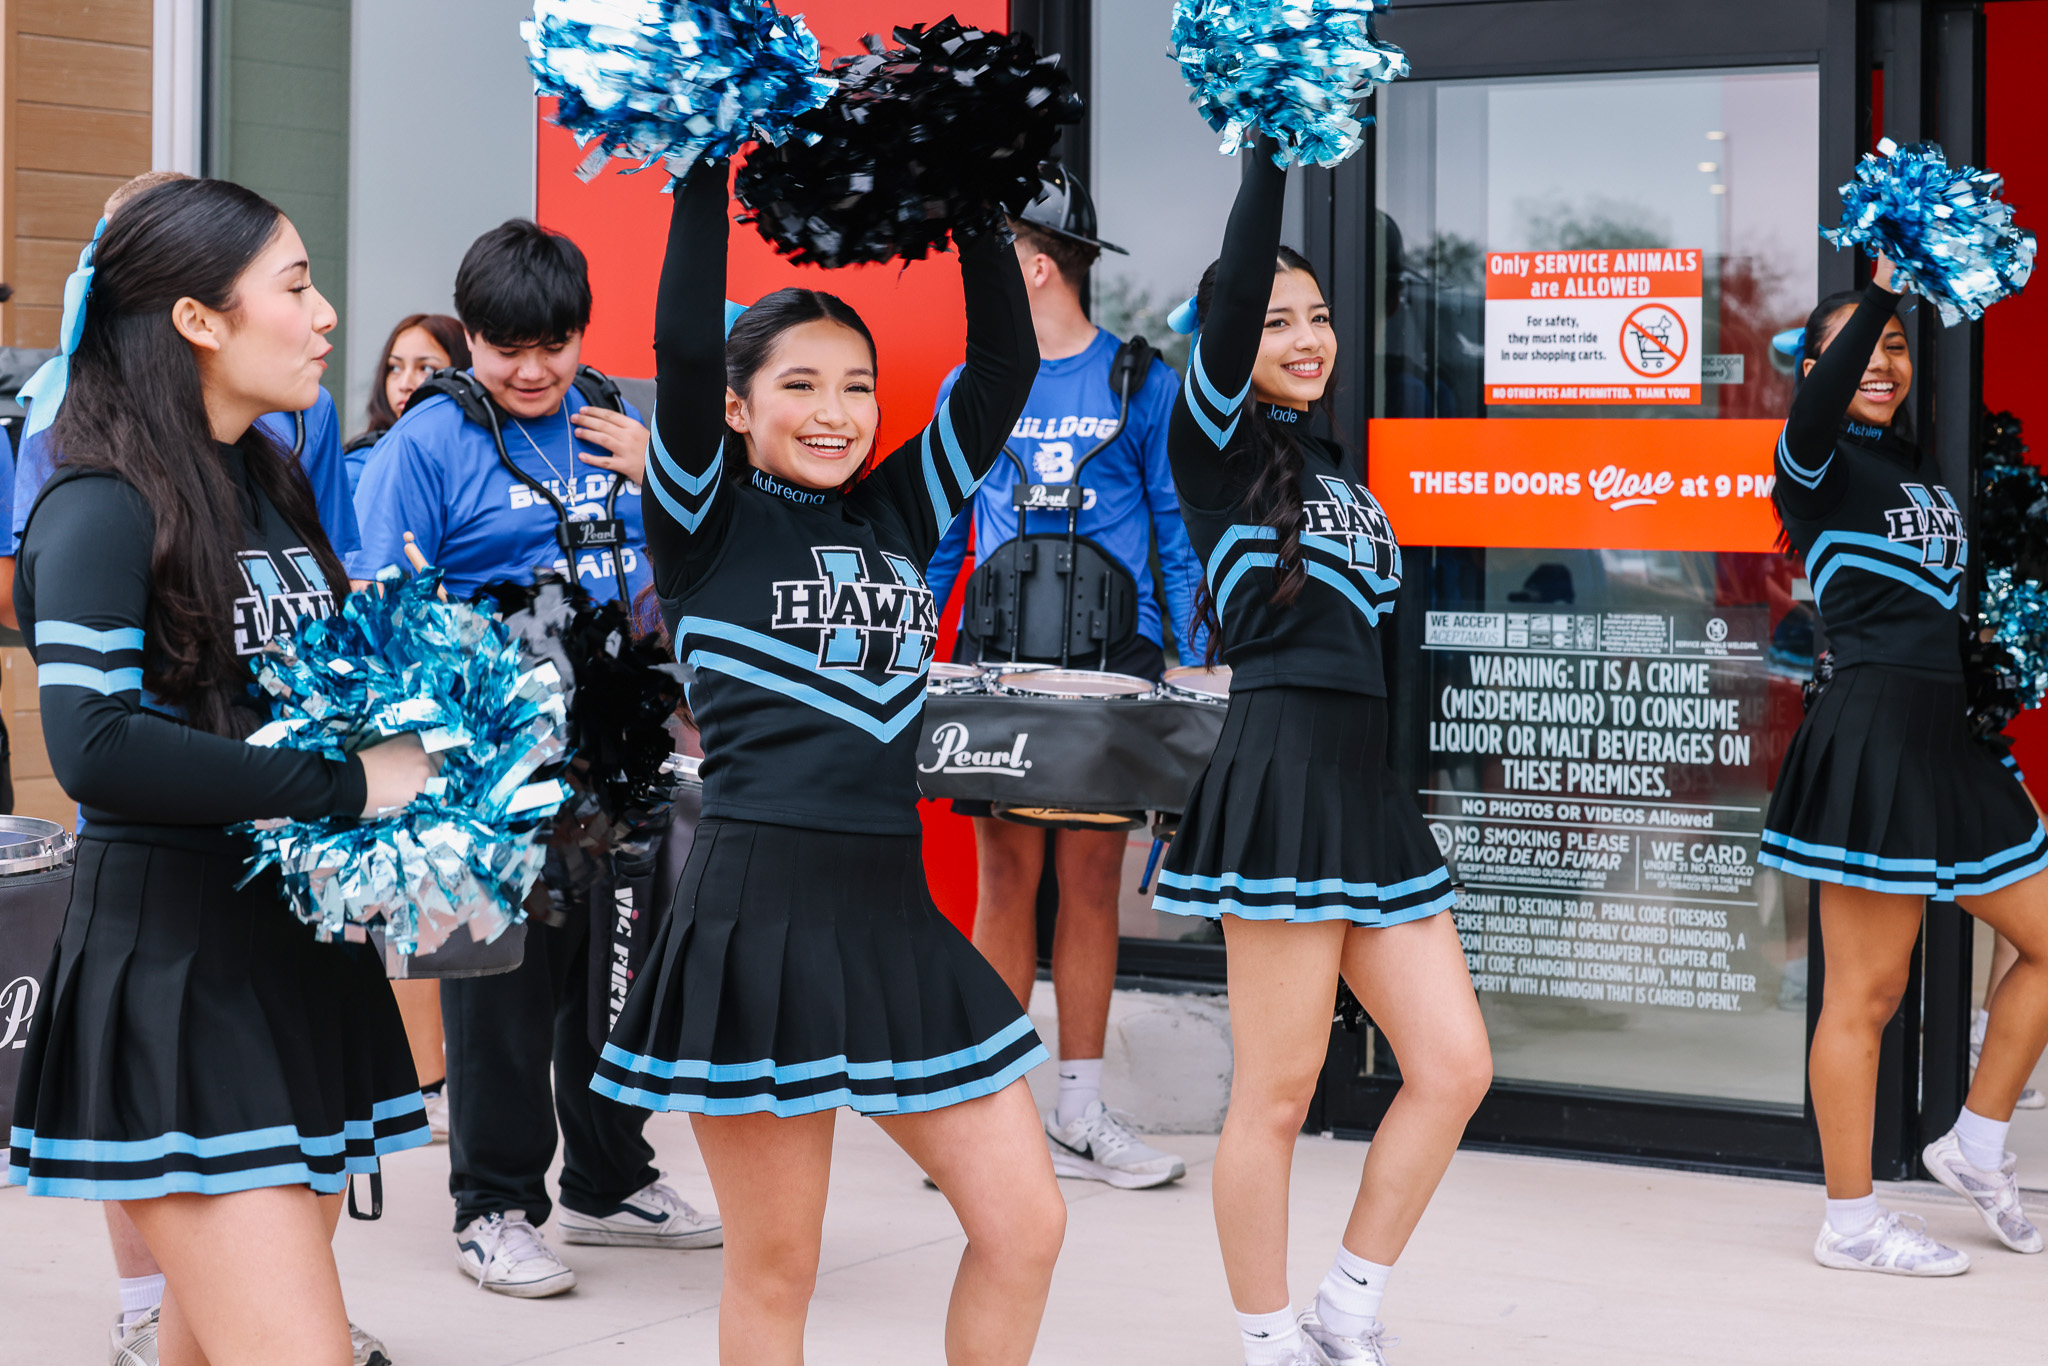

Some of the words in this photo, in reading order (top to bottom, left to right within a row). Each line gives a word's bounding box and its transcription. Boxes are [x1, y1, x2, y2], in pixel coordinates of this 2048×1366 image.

[1491, 255, 1529, 277] Only
[1534, 253, 1608, 274] SERVICE
[1614, 252, 1697, 273] ANIMALS
[1531, 281, 1559, 297] are
[1565, 276, 1651, 297] ALLOWED
[1527, 316, 1543, 327] For
[1545, 316, 1579, 330] safety,
[1509, 332, 1530, 347] they
[1532, 333, 1557, 343] must
[1560, 333, 1576, 343] not
[1579, 332, 1598, 343] ride
[1501, 350, 1510, 361] in
[1512, 351, 1528, 361] our
[1531, 349, 1576, 363] shopping
[1578, 349, 1606, 360] carts.
[1493, 388, 1505, 398] NO
[1507, 388, 1535, 398] OTHER
[1537, 388, 1559, 398] PETS
[1560, 388, 1578, 398] ARE
[1579, 387, 1632, 398] PERMITTED.
[1635, 387, 1664, 398] THANK
[1667, 387, 1690, 398] YOU!
[1267, 404, 1298, 423] Jade
[1011, 416, 1119, 439] ULLDOG
[1847, 422, 1883, 441] Ashley
[752, 469, 825, 505] Aubreana
[1024, 484, 1070, 506] Pearl
[1410, 472, 1488, 494] THESE
[1494, 472, 1580, 495] DOORS
[1588, 464, 1674, 501] Close
[1680, 475, 1709, 497] at
[1715, 475, 1732, 497] 9
[577, 522, 617, 544] Pearl
[1303, 501, 1398, 548] HAW
[1884, 507, 1968, 542] HAW
[771, 581, 938, 639] HAWK
[1431, 615, 1450, 627] WE
[1454, 616, 1499, 628] ACCEPT
[1429, 630, 1499, 644] ACEPTAMOS
[1675, 640, 1699, 648] SERVICE
[1470, 655, 1574, 689] WARNING:
[1580, 659, 1599, 688] IT
[1603, 660, 1622, 691] IS
[1626, 661, 1642, 692] A
[1647, 662, 1710, 694] CRIME
[1441, 685, 1605, 726] (MISDEMEANOR)
[1610, 695, 1636, 726] TO
[1641, 697, 1739, 730] CONSUME
[1429, 721, 1502, 755] LIQUOR
[1508, 725, 1536, 756] OR
[1541, 726, 1592, 759] MALT
[1599, 729, 1714, 765] BEVERAGES
[1719, 735, 1750, 766] ON
[1502, 759, 1562, 792] THESE
[1567, 762, 1671, 798] PREMISES.
[1462, 800, 1486, 815] NO
[1489, 802, 1553, 819] PHOTOS
[1557, 804, 1581, 820] OR
[1584, 806, 1645, 824] VIDEOS
[1648, 808, 1713, 828] Allowed
[1455, 826, 1480, 843] NO
[1484, 828, 1561, 848] SMOKING
[1567, 832, 1630, 852] PLEASE
[1454, 844, 1506, 863] FAVOR
[1509, 848, 1533, 865] DE
[1534, 850, 1559, 867] NO
[1562, 851, 1622, 870] FUMAR
[1651, 841, 1685, 861] WE
[1690, 844, 1747, 864] CARD
[1457, 863, 1485, 873] EXCEPT
[1486, 865, 1494, 874] IN
[1495, 865, 1541, 877] DESIGNATED
[1542, 868, 1580, 879] OUTDOOR
[1581, 870, 1607, 881] AREAS
[1643, 860, 1676, 871] UNDER
[1678, 862, 1688, 872] 21
[1691, 863, 1706, 873] NO
[1708, 864, 1754, 876] TOBACCO
[1453, 893, 1501, 913] URSUANT
[1503, 896, 1517, 913] TO
[1518, 897, 1562, 916] SECTION
[1563, 900, 1596, 921] 30.07,
[1601, 903, 1636, 922] PENAL
[1638, 905, 1667, 924] CODE
[1669, 907, 1727, 928] (TRESPASS
[1485, 915, 1527, 934] HOLDER
[1529, 918, 1558, 936] WITH
[1560, 920, 1577, 937] AN
[1578, 922, 1620, 941] OPENLY
[1621, 925, 1668, 944] CARRIED
[1670, 928, 1735, 952] HANDGUN),
[1737, 933, 1746, 950] A
[1484, 935, 1532, 954] LICENSED
[1534, 938, 1571, 957] UNDER
[1573, 940, 1641, 963] SUBCHAPTER
[1644, 947, 1656, 966] H,
[1659, 948, 1708, 968] CHAPTER
[1709, 952, 1731, 972] 411,
[1488, 955, 1515, 973] CODE
[1517, 957, 1576, 977] (HANDGUN
[1578, 962, 1632, 982] LICENSING
[1635, 966, 1668, 987] LAW),
[1670, 969, 1694, 987] MAY
[1696, 972, 1719, 989] NOT
[1721, 973, 1756, 992] ENTER
[1509, 976, 1538, 995] WITH
[1540, 979, 1548, 996] A
[1550, 980, 1604, 1000] HANDGUN
[1606, 984, 1633, 1002] THAT
[1635, 986, 1645, 1004] IS
[1648, 988, 1695, 1007] CARRIED
[1697, 991, 1741, 1011] OPENLY.
